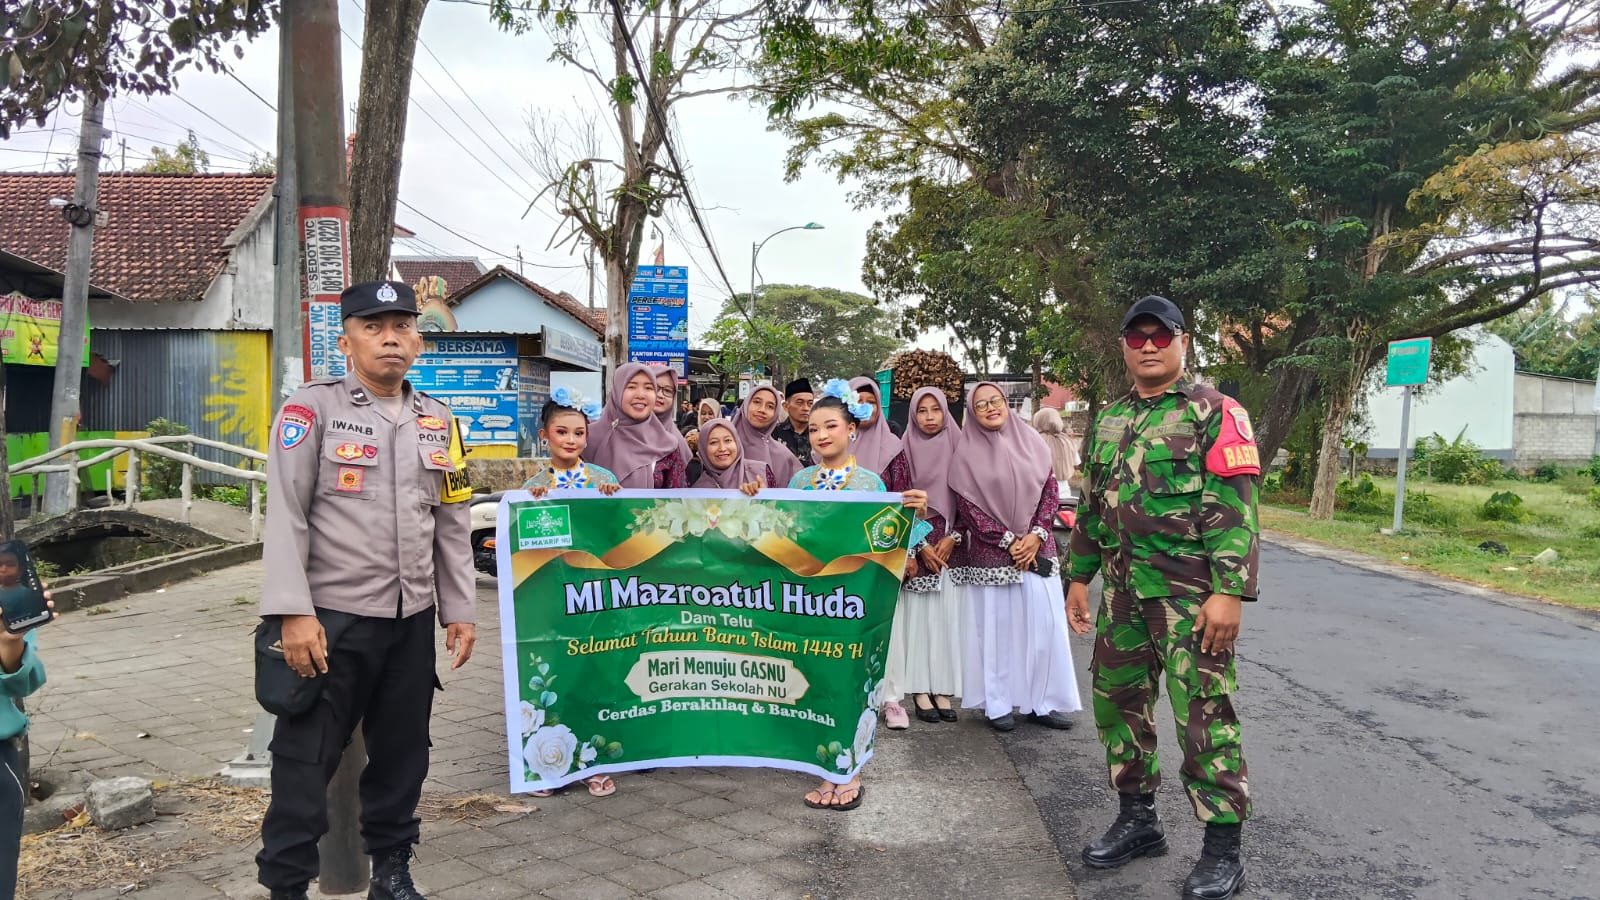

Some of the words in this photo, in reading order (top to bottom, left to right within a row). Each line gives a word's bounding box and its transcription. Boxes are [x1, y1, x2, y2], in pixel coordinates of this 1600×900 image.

[305, 220, 316, 240] WC
[317, 220, 341, 242] 8220
[306, 243, 318, 281] SEDOT
[319, 245, 342, 267] 3103
[320, 270, 344, 292] 0813
[311, 305, 324, 323] WC
[311, 327, 325, 366] SEDOT
[437, 341, 505, 353] BERSAMA
[328, 354, 346, 376] 0812
[332, 420, 373, 436] IWAN.B
[531, 539, 560, 547] MA'ARIF
[563, 579, 606, 616] MI
[609, 576, 776, 612] Mazroatul
[780, 581, 867, 620] Huda
[680, 611, 717, 625] Dam
[720, 613, 753, 628] Telu
[567, 632, 638, 656] Selamat
[641, 627, 699, 645] Tahun
[702, 626, 748, 646] Baru
[751, 631, 799, 654] Islam
[803, 638, 844, 659] 1448
[849, 641, 864, 660] H
[648, 656, 680, 677] Mari
[684, 656, 736, 678] Menuju
[740, 660, 786, 683] GASNU
[648, 679, 707, 694] Gerakan
[711, 679, 764, 696] Sekolah
[768, 685, 787, 699] NU
[597, 705, 657, 722] Cerdas
[660, 699, 749, 715] Berakhlaq
[751, 702, 766, 714] &
[768, 703, 836, 728] Barokah
